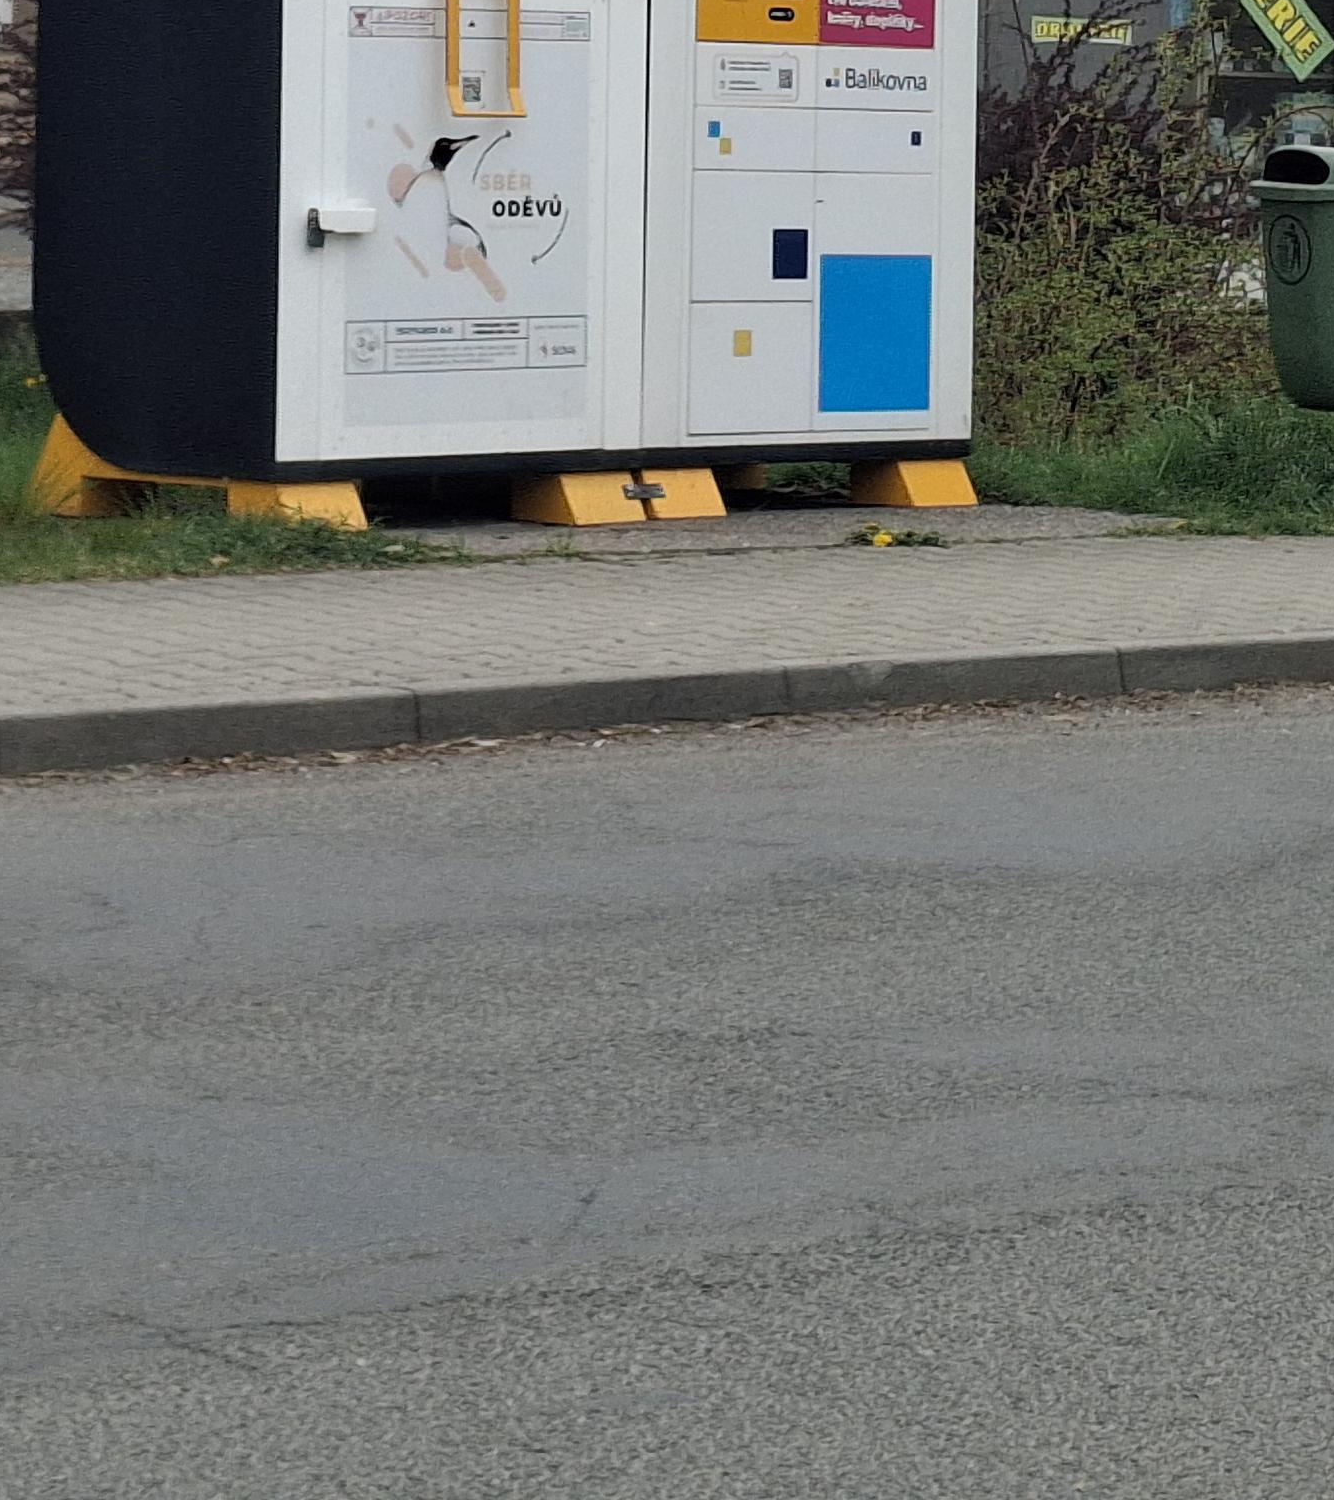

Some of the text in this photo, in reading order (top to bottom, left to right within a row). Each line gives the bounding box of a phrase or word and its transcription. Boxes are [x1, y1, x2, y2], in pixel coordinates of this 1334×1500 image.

[845, 68, 927, 91] Balíkovna
[480, 169, 531, 191] SBĚR
[492, 194, 562, 217] ODĚVŮ
